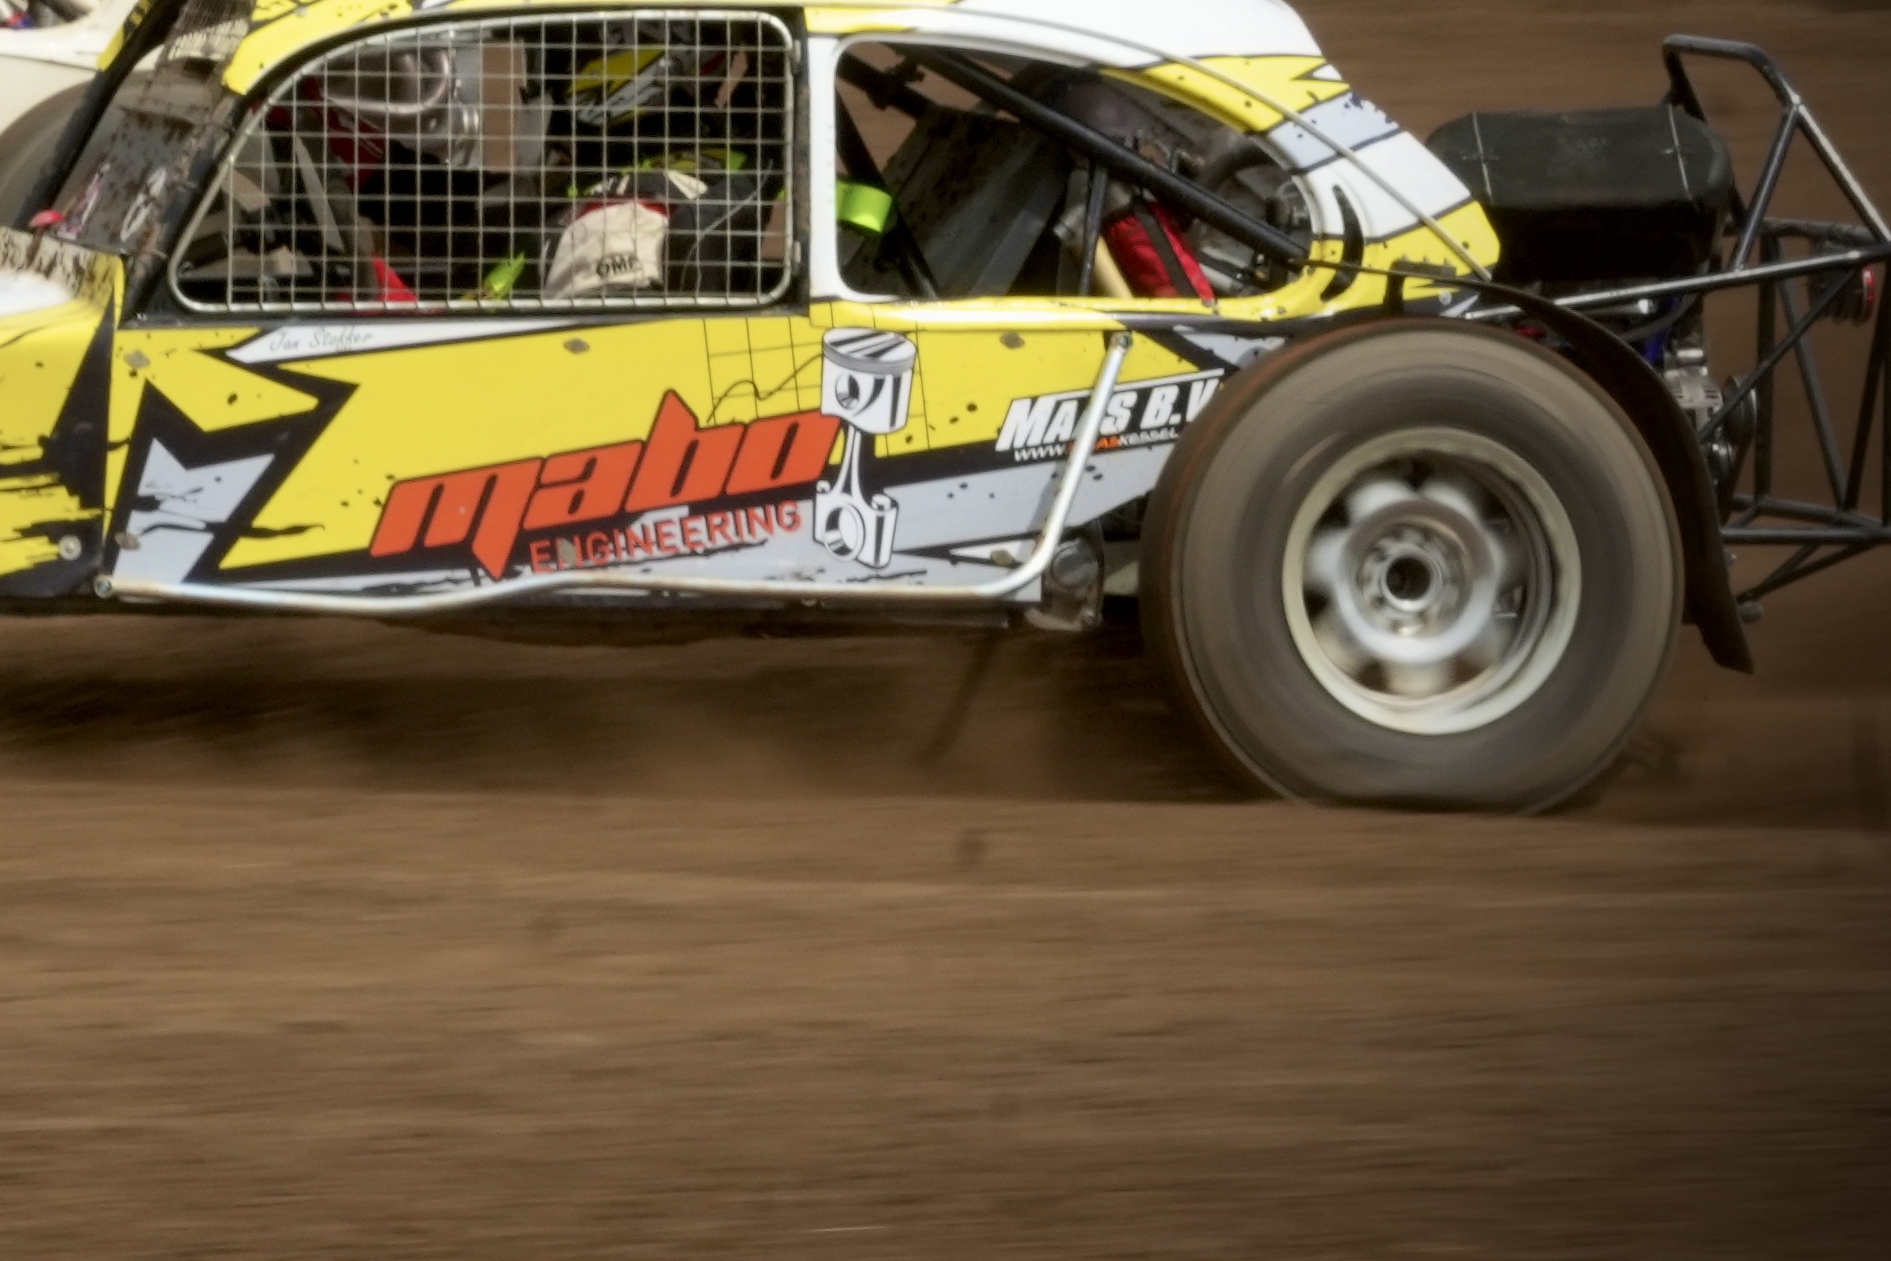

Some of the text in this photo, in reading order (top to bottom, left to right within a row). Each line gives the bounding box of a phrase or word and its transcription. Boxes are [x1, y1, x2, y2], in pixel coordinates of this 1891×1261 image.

[995, 390, 1139, 453] MAS
[368, 388, 842, 581] mabo
[528, 500, 803, 574] ENGINEERING
